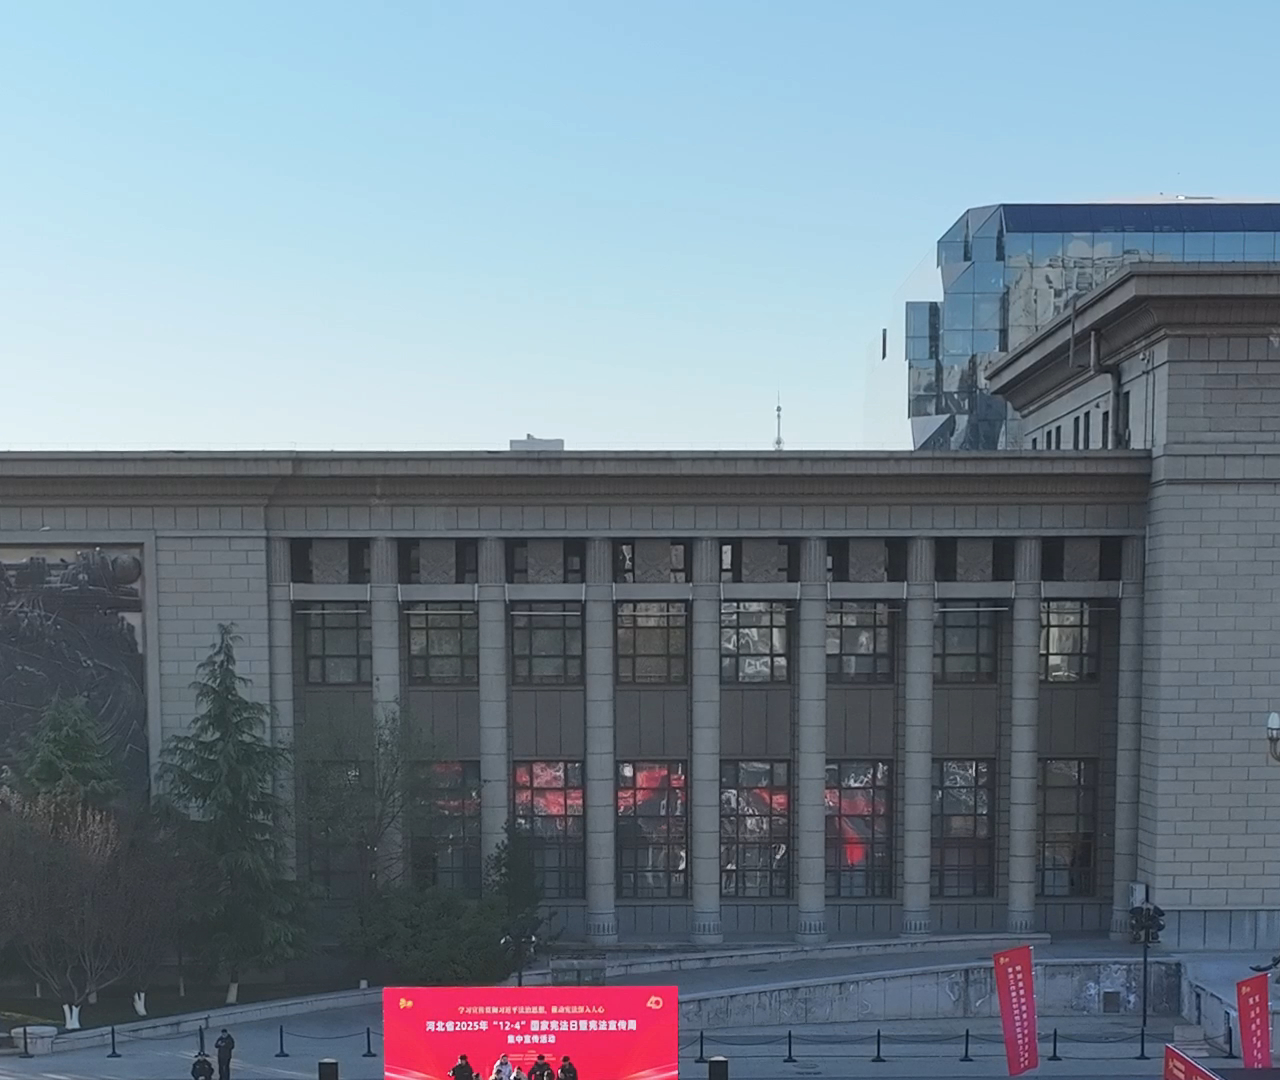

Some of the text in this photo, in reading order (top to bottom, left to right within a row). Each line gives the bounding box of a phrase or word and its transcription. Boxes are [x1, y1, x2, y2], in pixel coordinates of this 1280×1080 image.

[507, 1034, 556, 1045] 集中宣传活动
